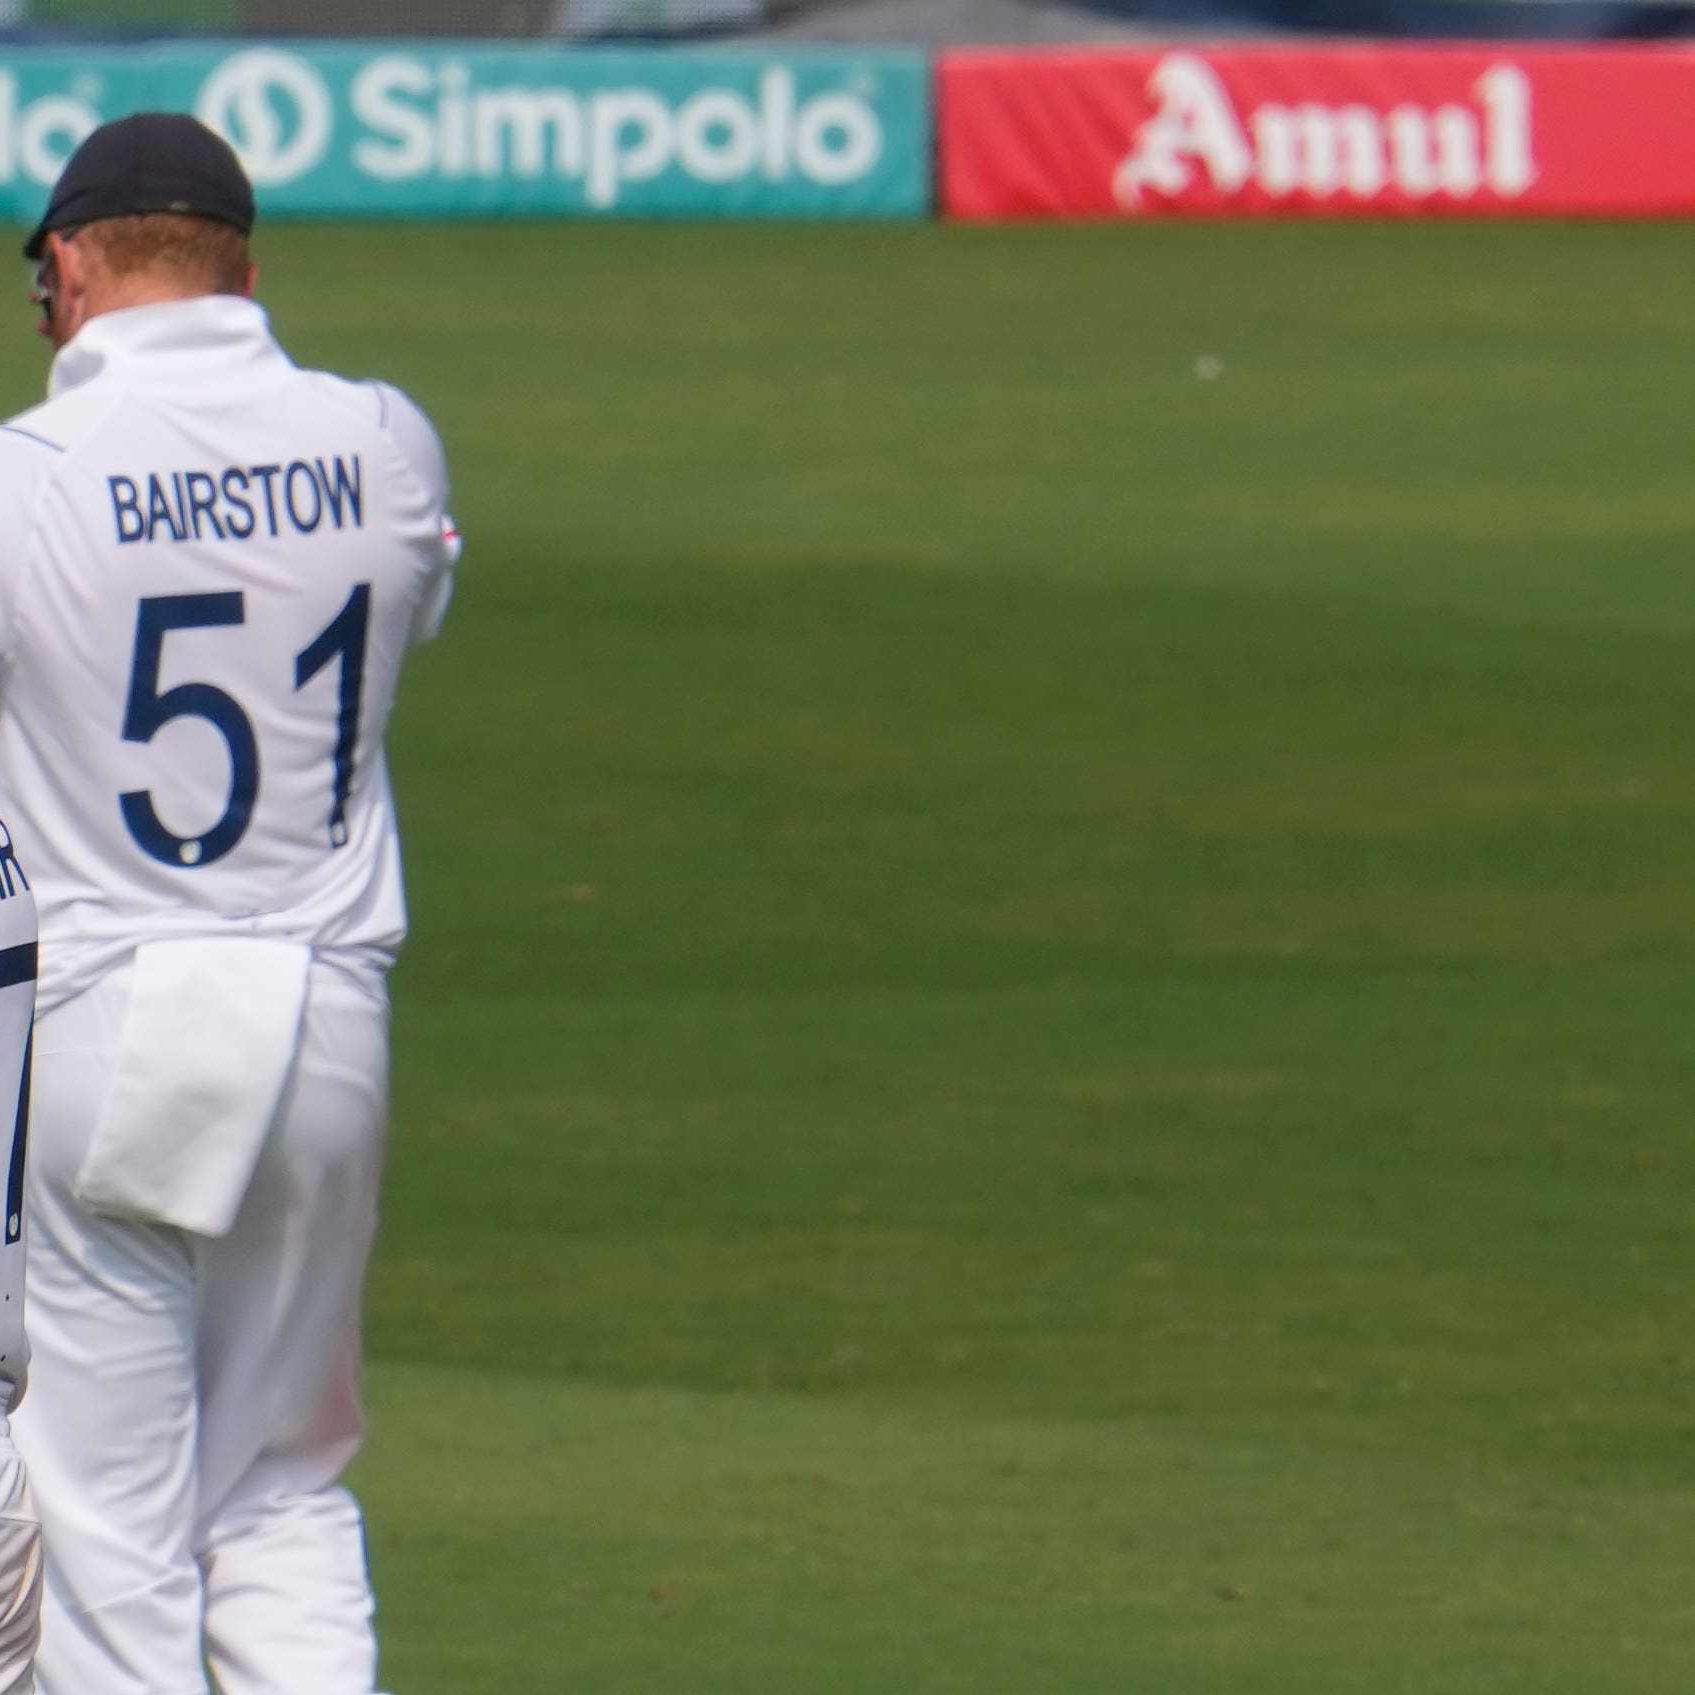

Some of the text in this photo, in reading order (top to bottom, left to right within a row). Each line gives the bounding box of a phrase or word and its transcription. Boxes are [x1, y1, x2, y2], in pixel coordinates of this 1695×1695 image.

[346, 54, 886, 209] Simpolo
[1112, 50, 1538, 213] Amul
[106, 453, 366, 545] BAIRSTOW
[118, 580, 373, 868] 51
